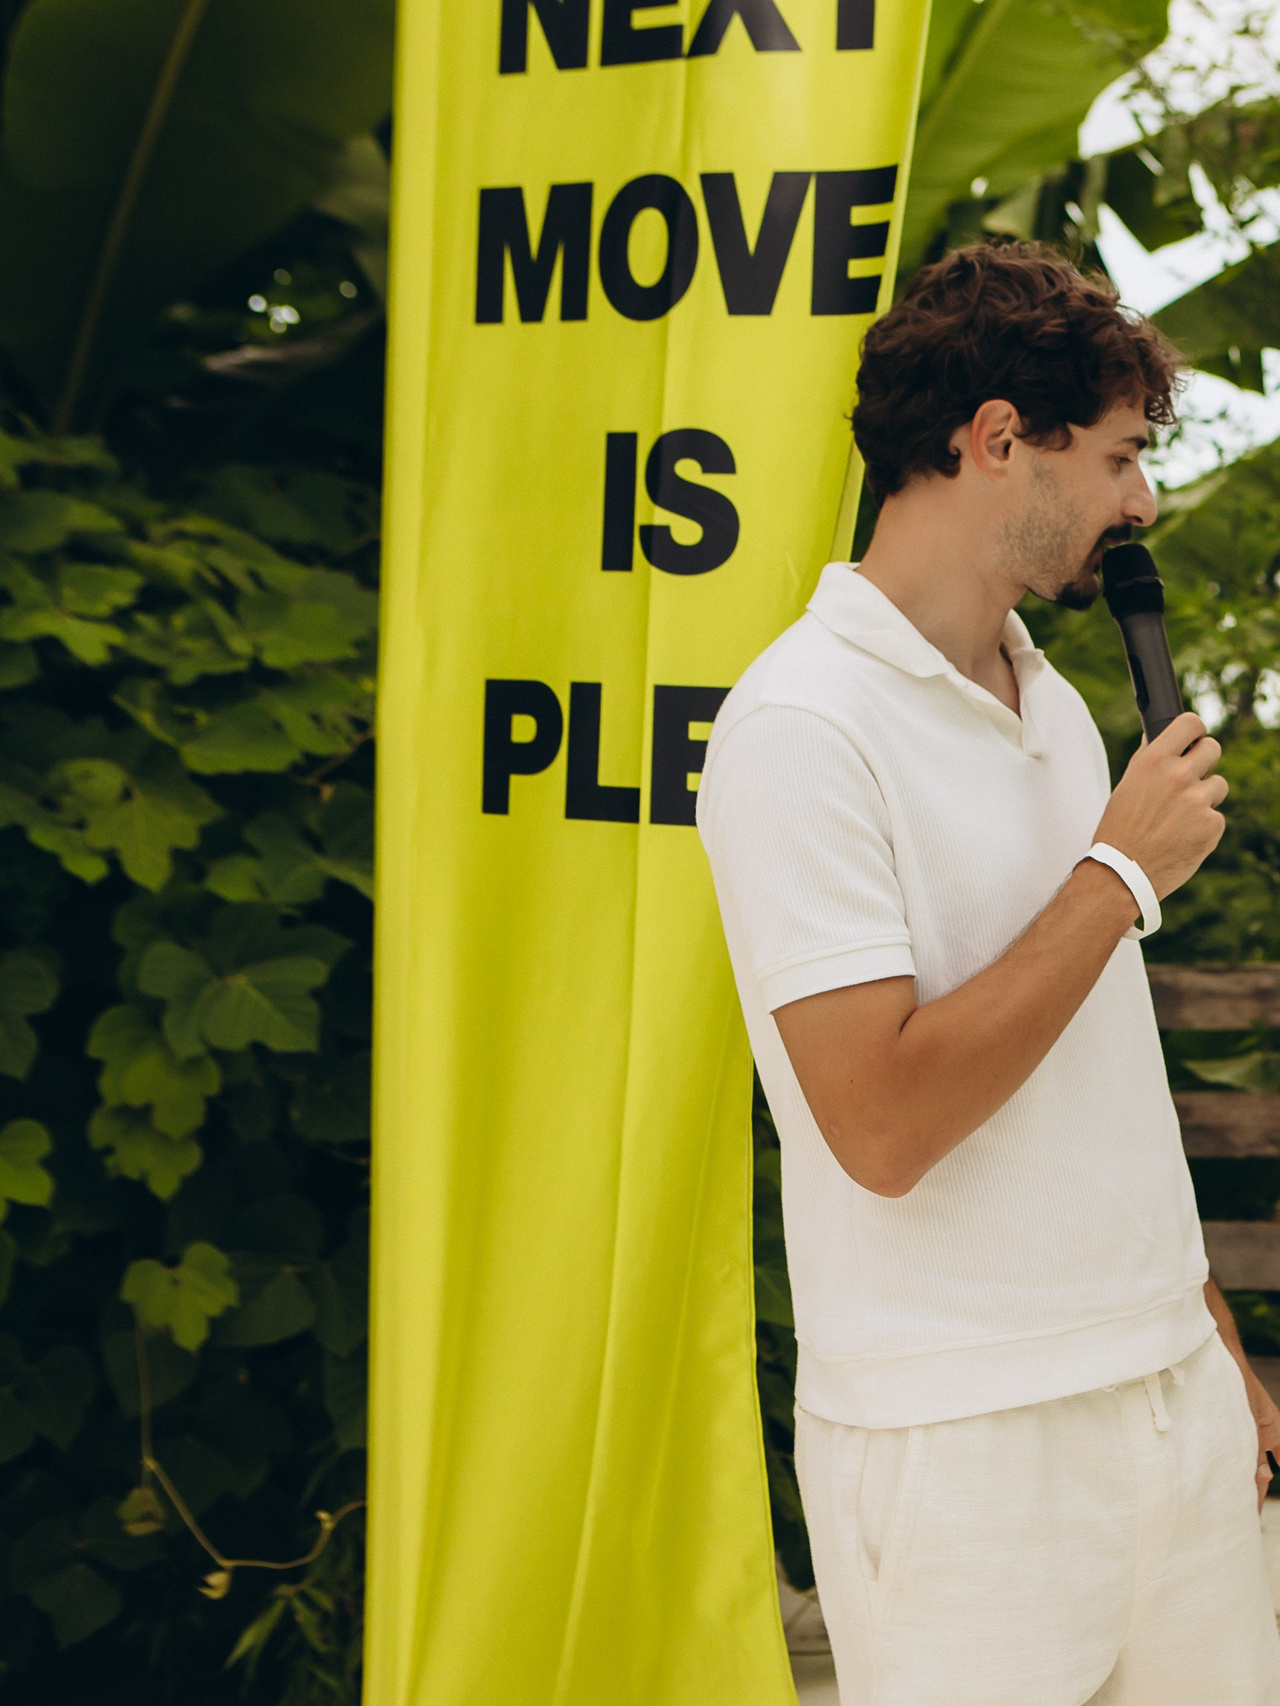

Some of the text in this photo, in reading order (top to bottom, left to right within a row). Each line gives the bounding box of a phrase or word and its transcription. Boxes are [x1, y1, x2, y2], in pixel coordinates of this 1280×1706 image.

[475, 164, 899, 324] MOVE
[601, 428, 740, 576] IS
[482, 678, 732, 827] PLE
